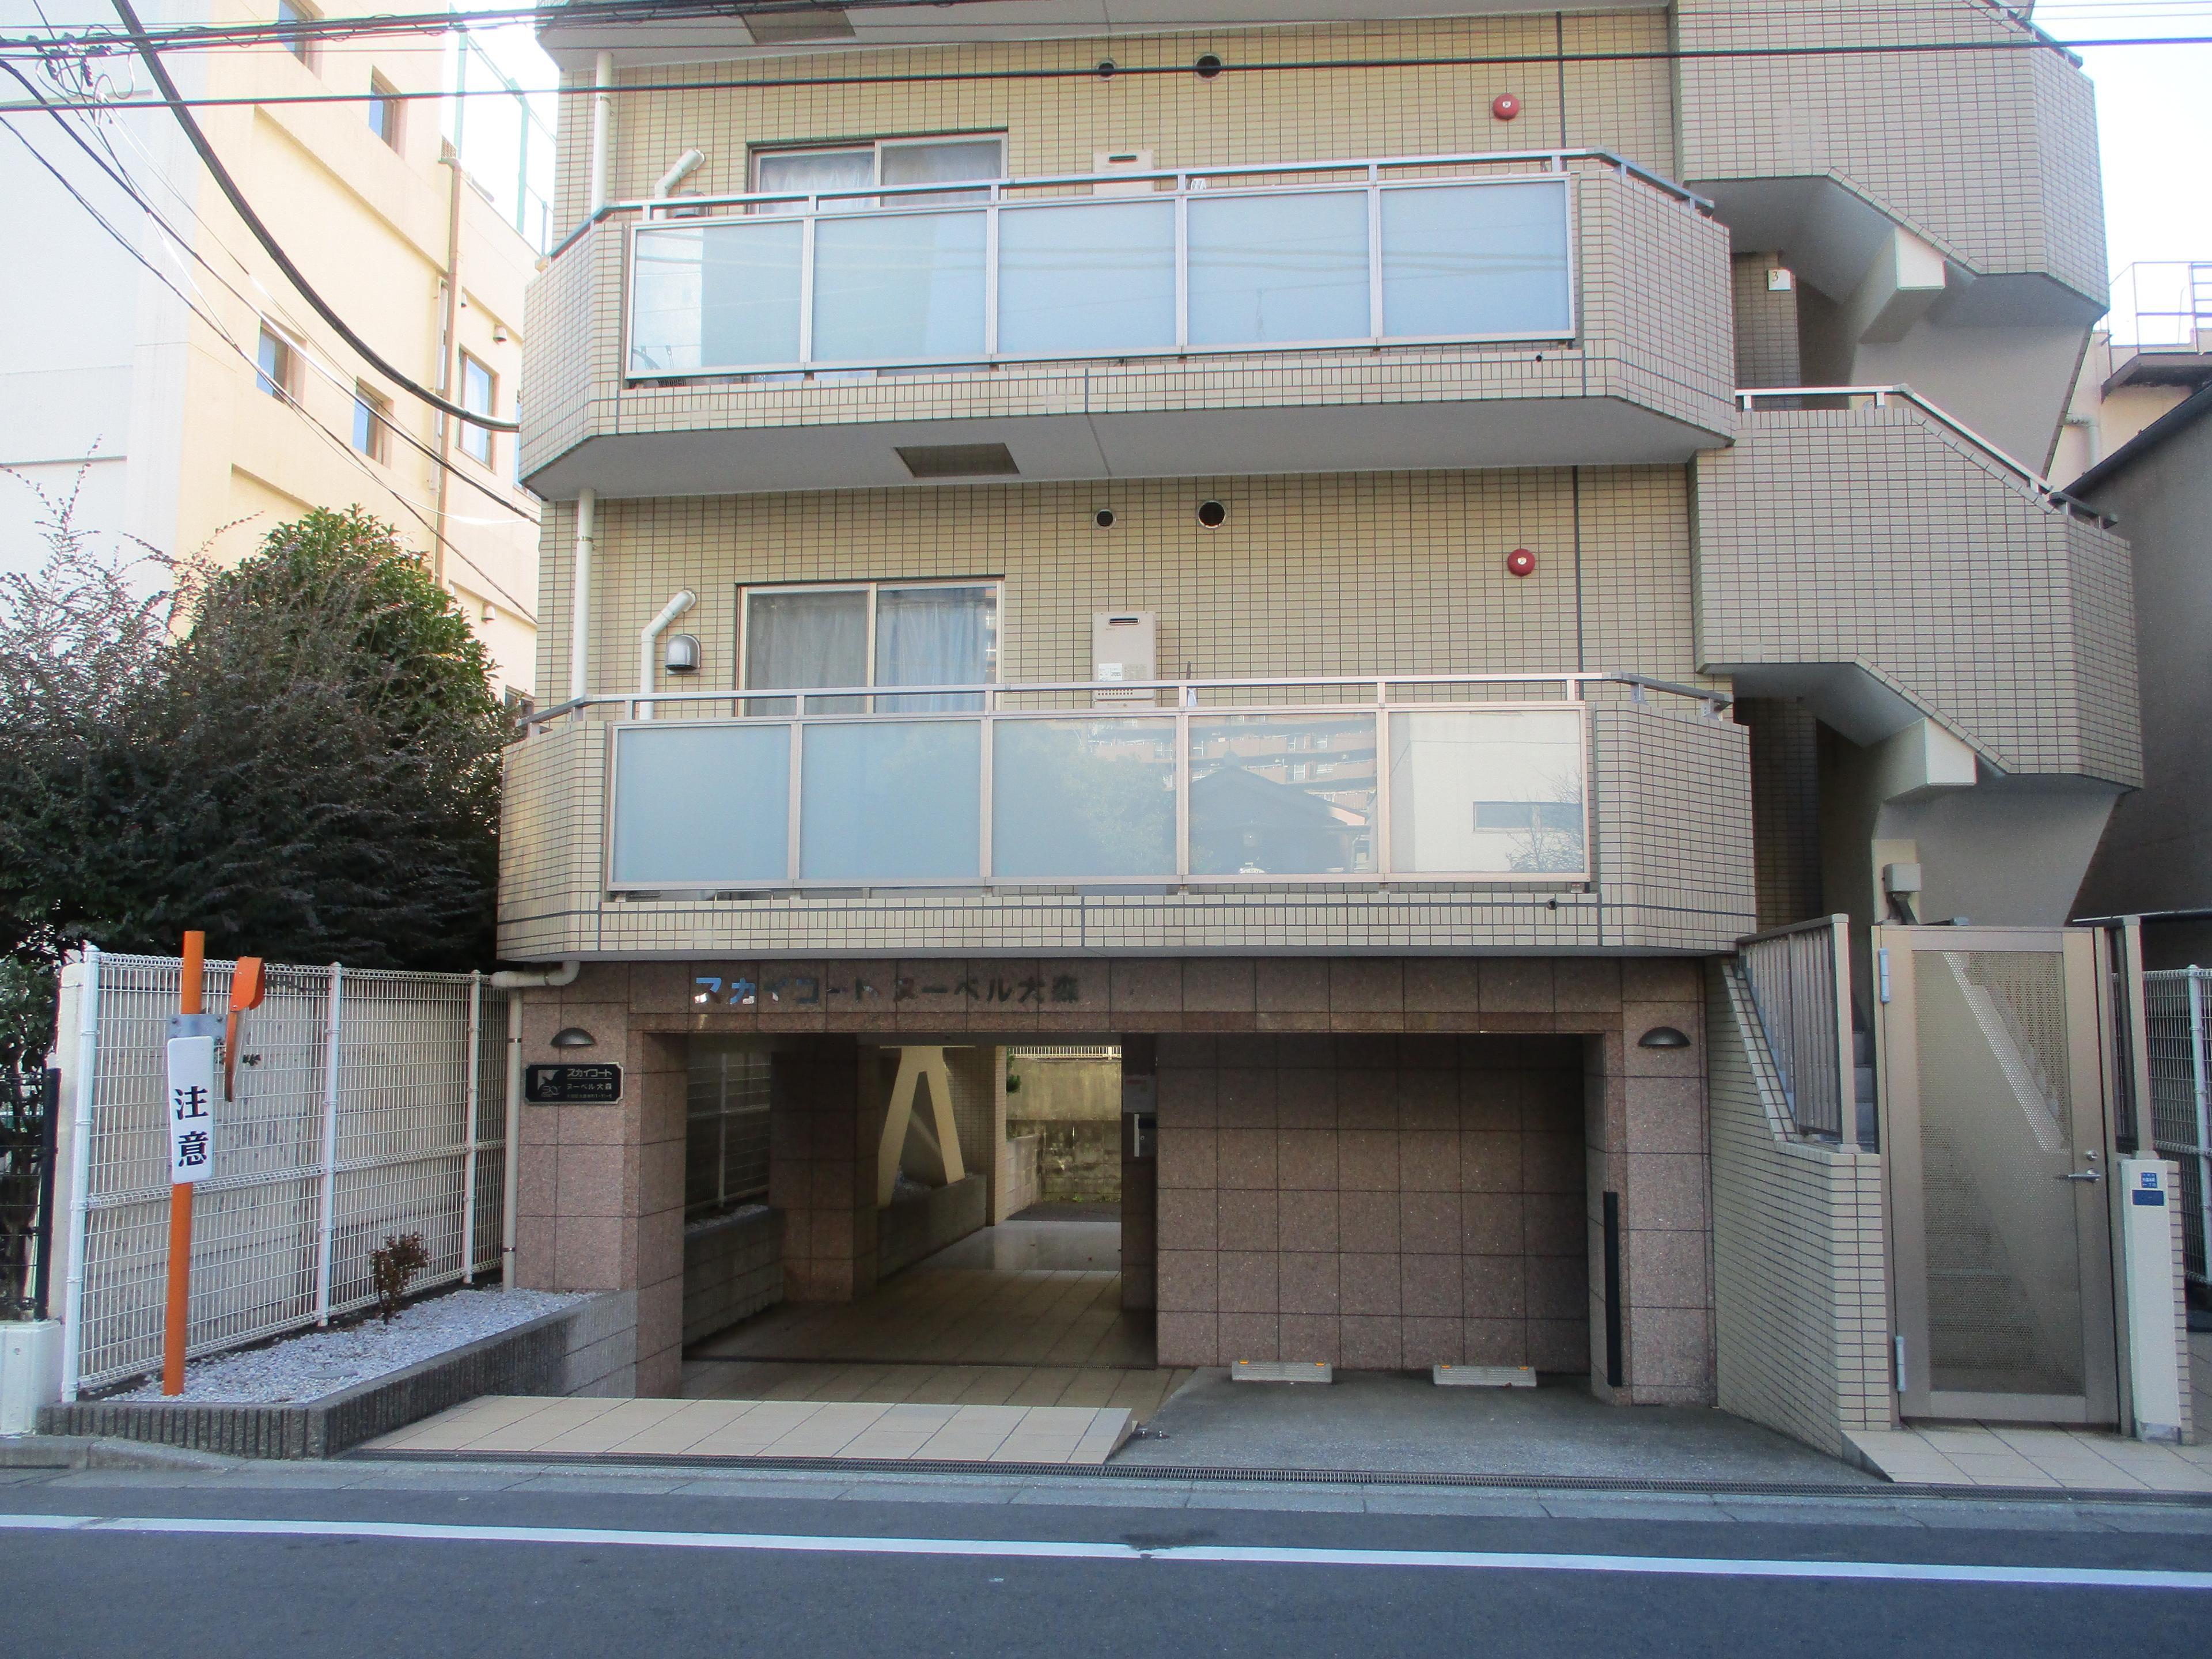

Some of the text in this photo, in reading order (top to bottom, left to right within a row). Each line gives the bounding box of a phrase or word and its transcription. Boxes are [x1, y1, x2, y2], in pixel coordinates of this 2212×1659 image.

[1772, 271, 1779, 282] 3
[567, 1069, 612, 1077] スカイコート
[175, 1086, 209, 1168] 注意
